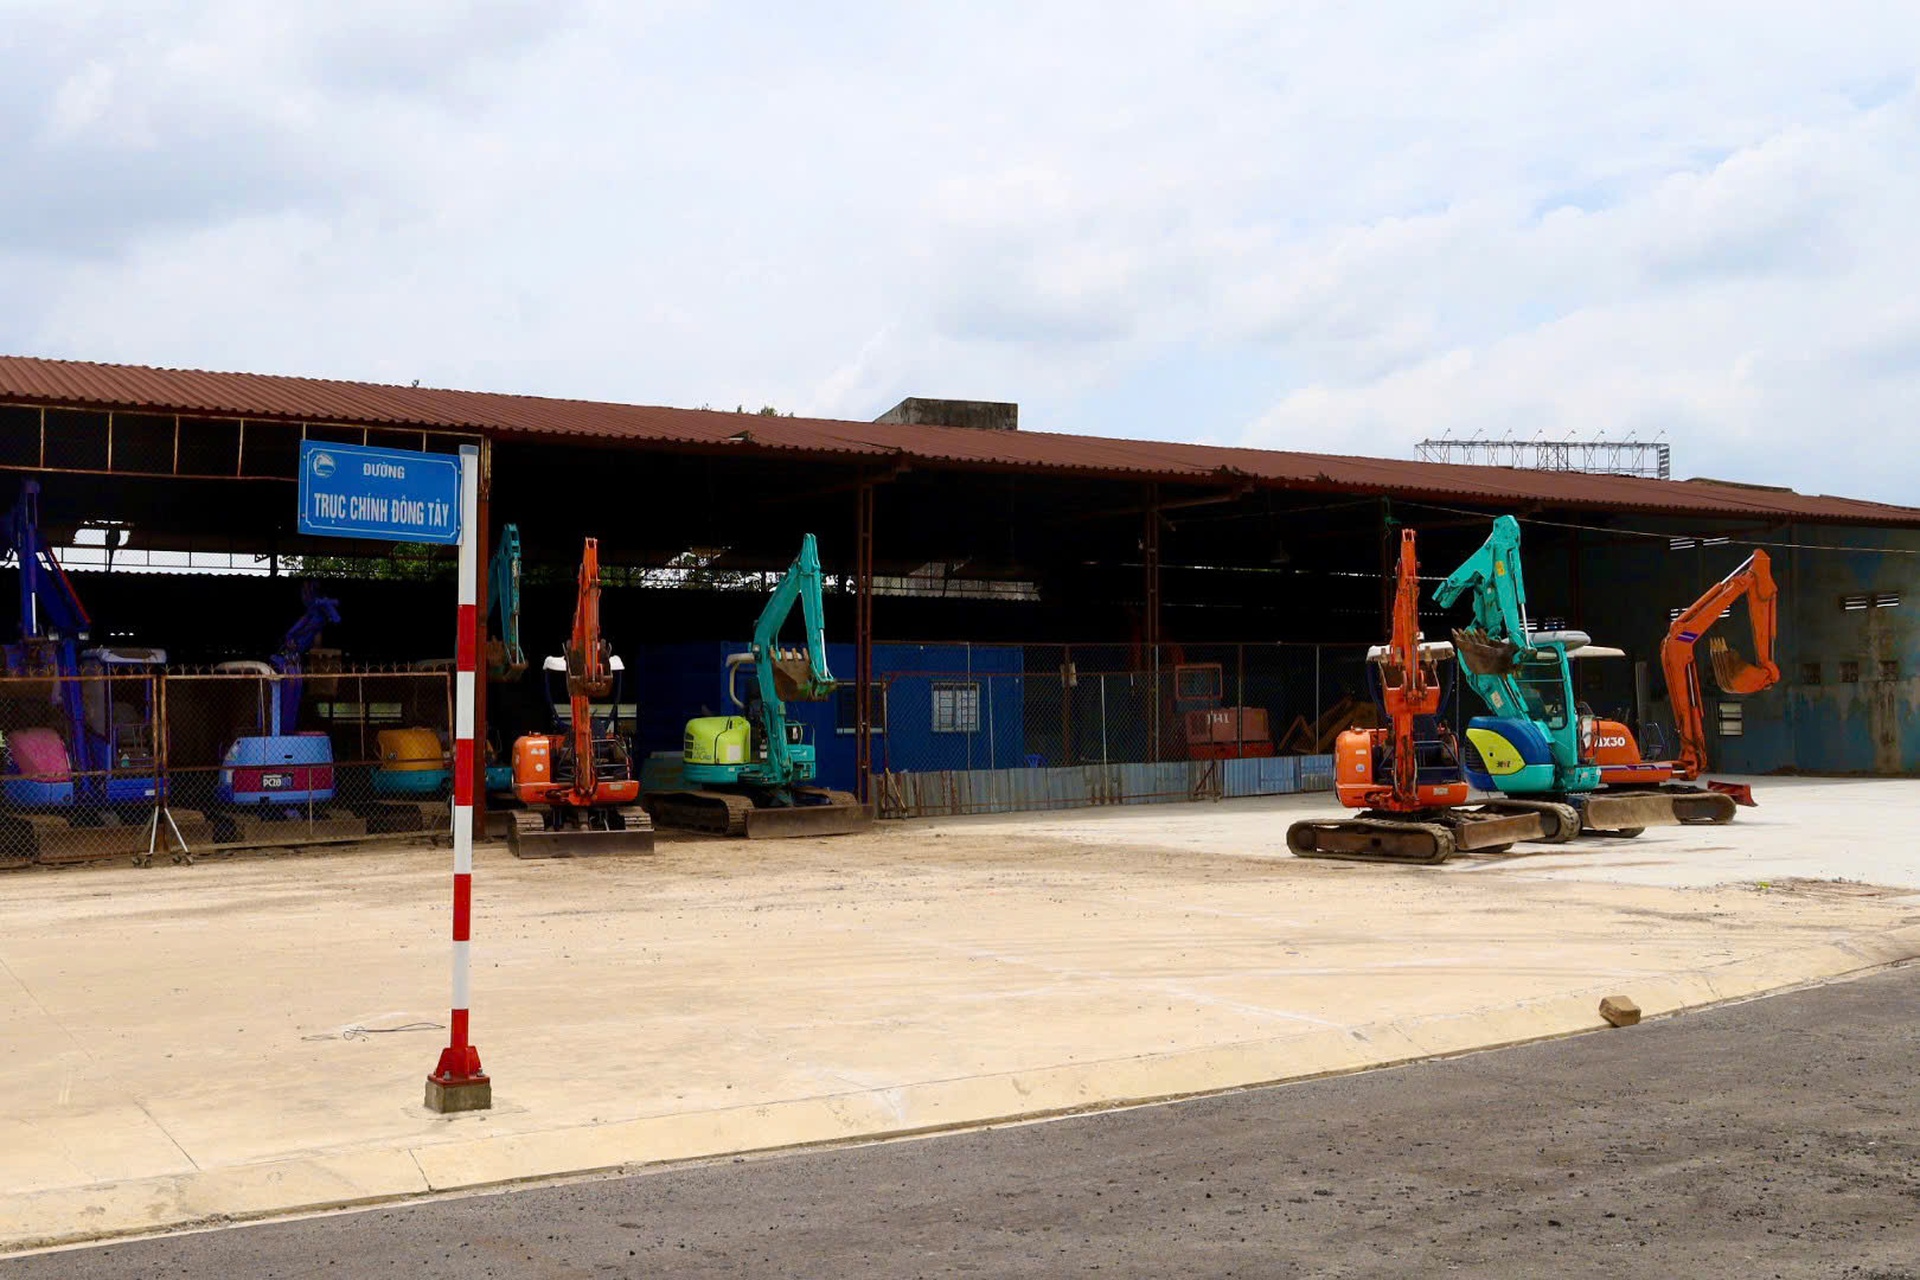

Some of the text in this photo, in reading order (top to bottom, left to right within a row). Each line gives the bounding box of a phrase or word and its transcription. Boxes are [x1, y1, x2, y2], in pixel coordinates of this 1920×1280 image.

[363, 461, 405, 479] ĐƯỜNG
[314, 492, 449, 527] TRỤC CHÍNH ĐÔNG TÂY
